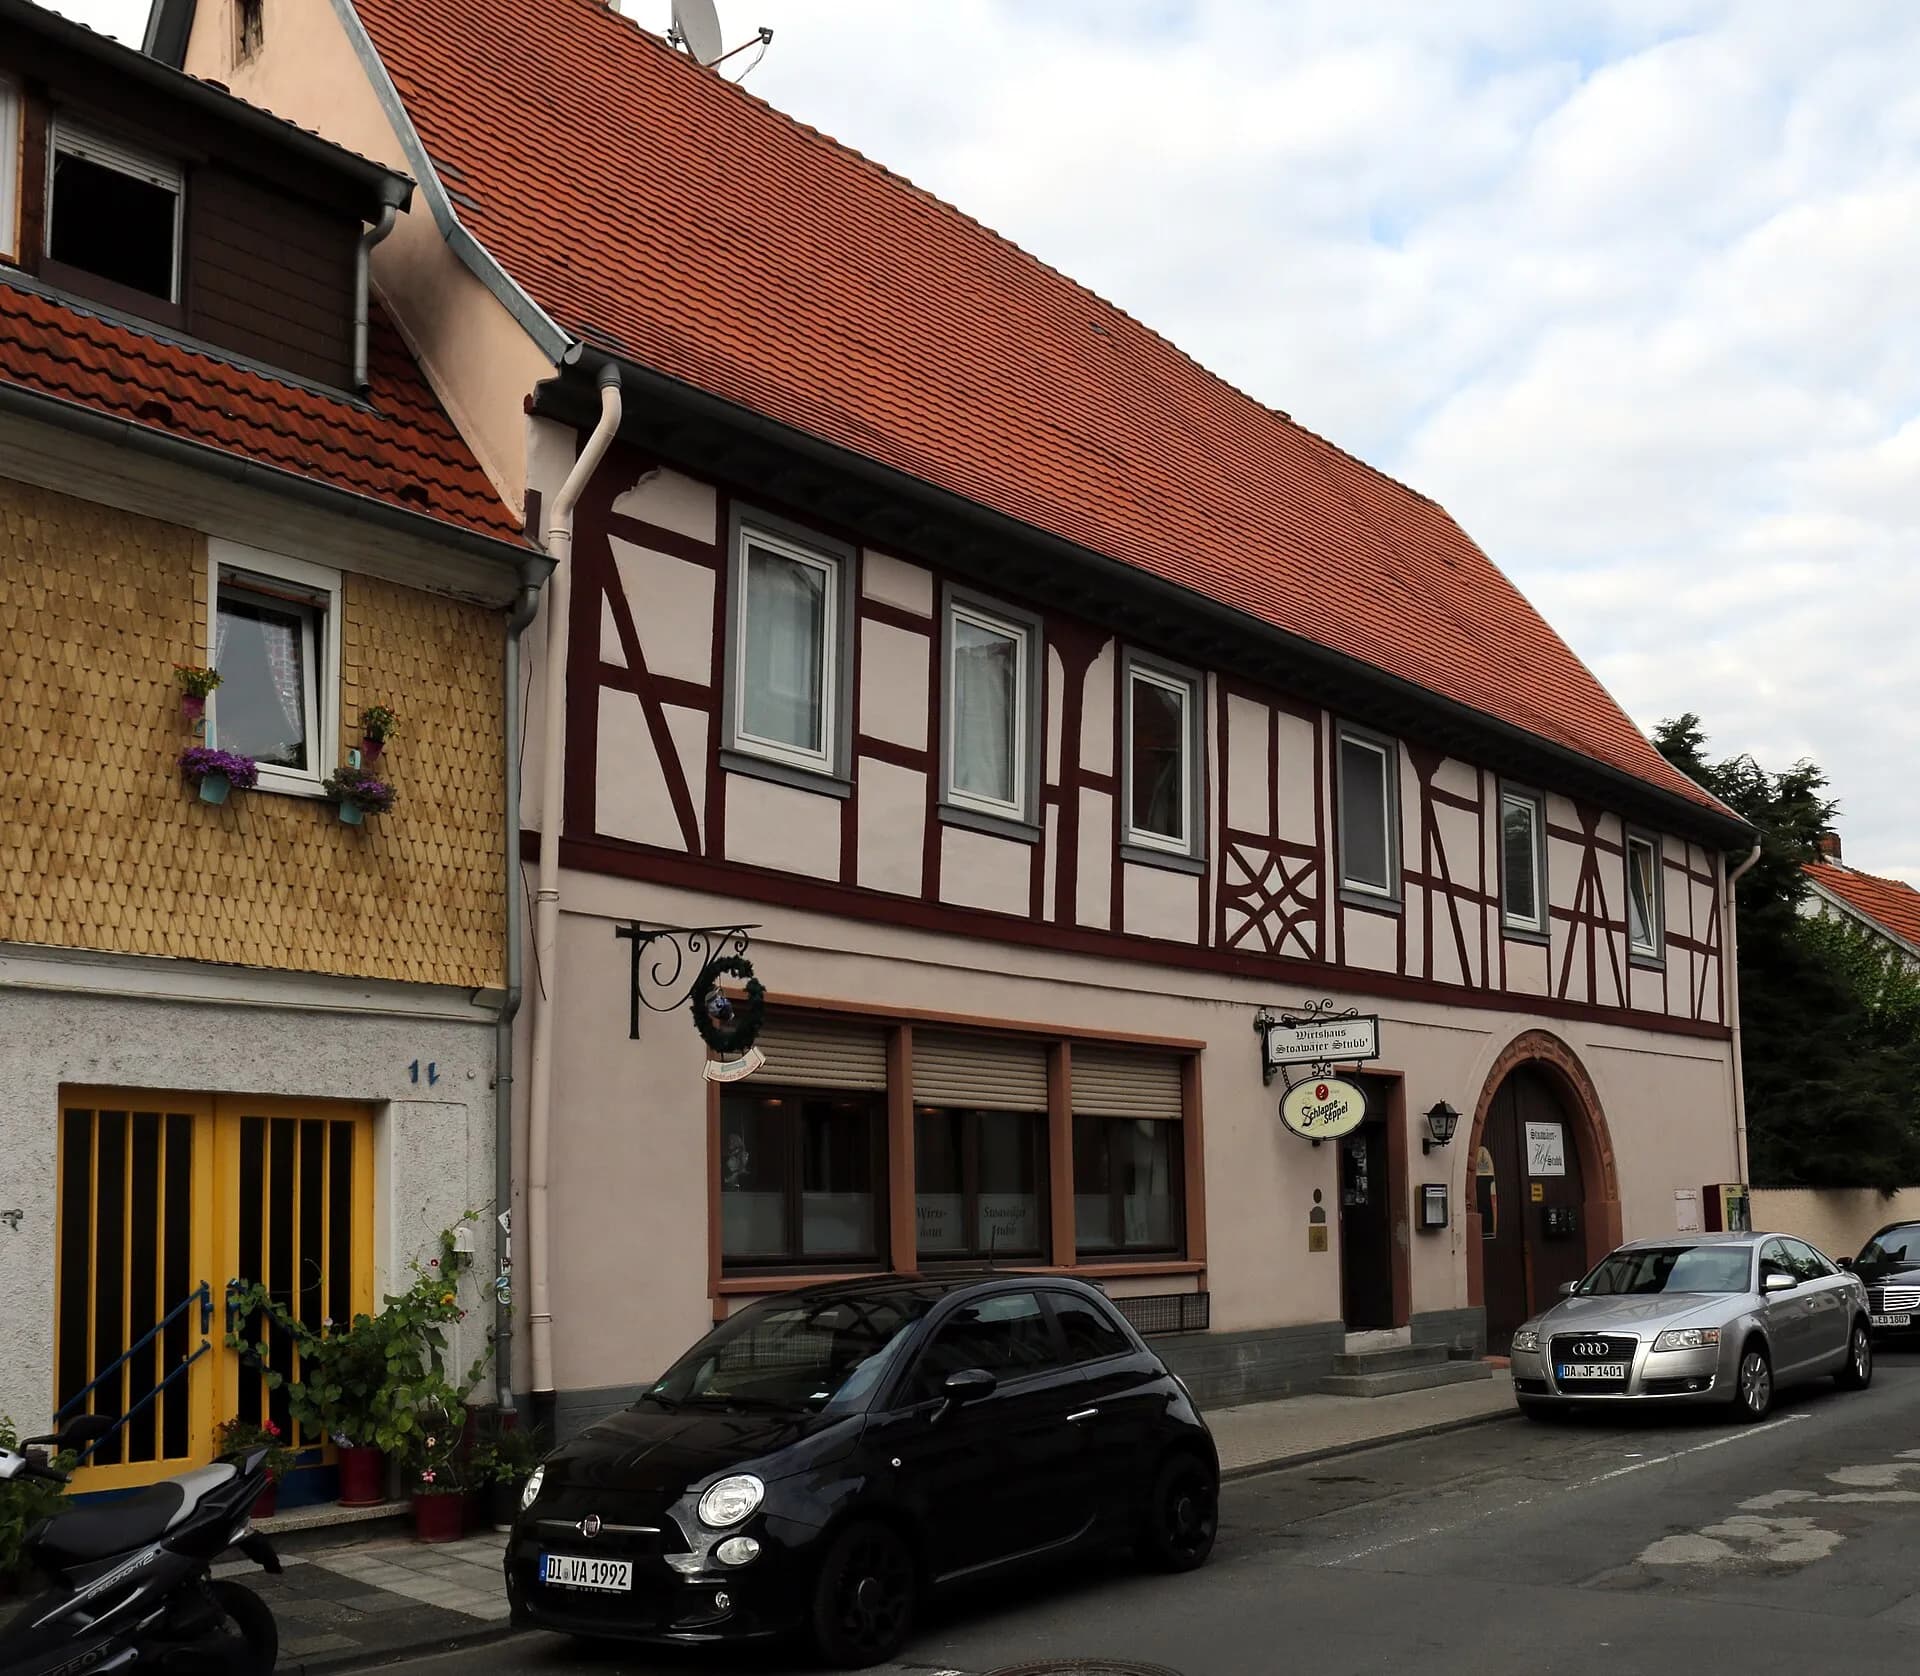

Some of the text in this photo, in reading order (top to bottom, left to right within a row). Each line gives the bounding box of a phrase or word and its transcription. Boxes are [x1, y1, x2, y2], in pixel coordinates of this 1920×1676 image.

[1296, 1028, 1346, 1040] Wirtshaus
[1564, 1365, 1623, 1377] DA JF 1401
[548, 1557, 627, 1587] DI VA 1992
